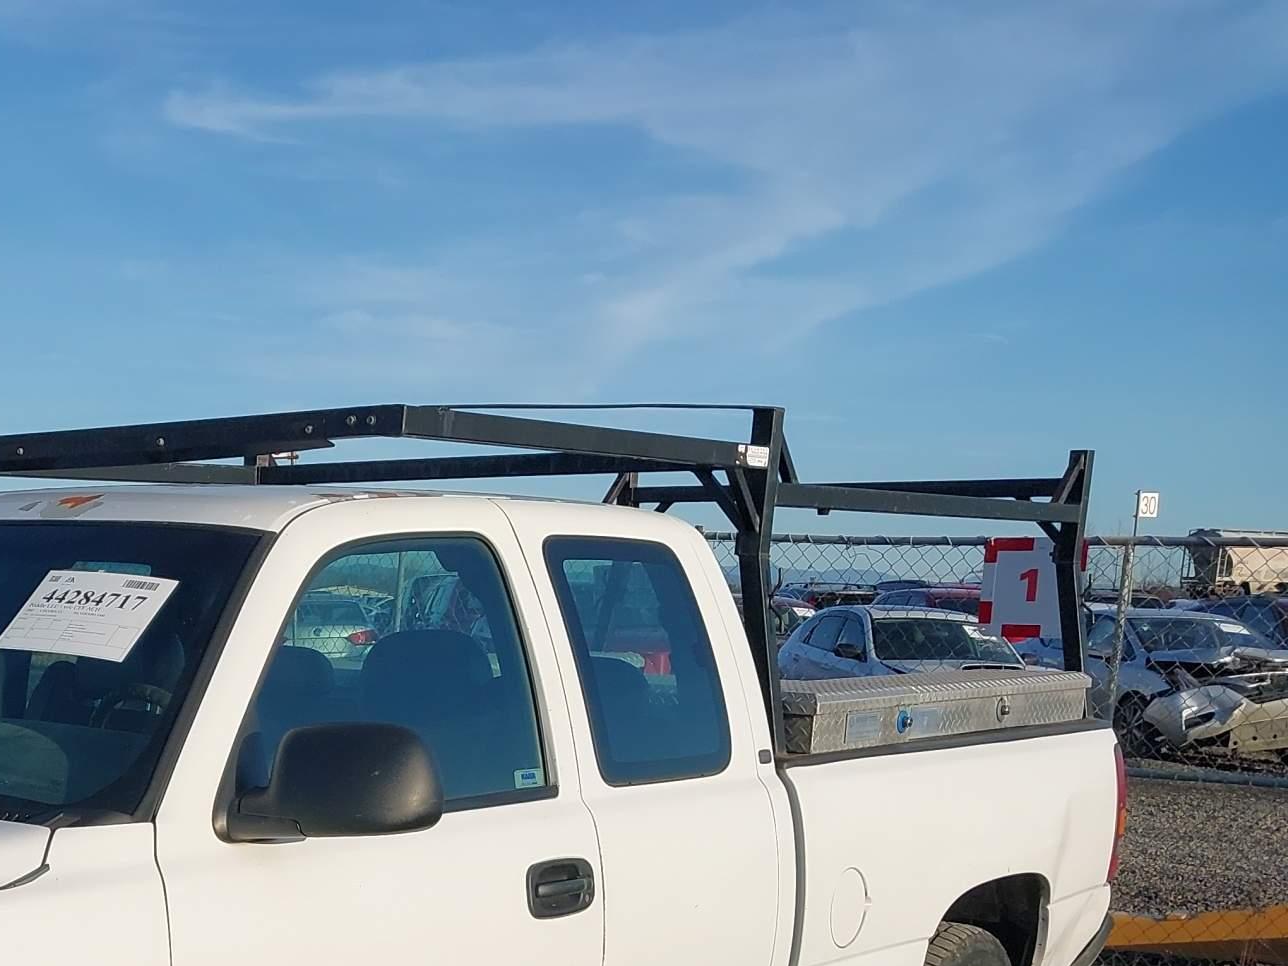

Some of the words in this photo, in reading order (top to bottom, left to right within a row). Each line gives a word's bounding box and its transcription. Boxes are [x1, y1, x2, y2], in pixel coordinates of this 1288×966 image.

[1140, 495, 1157, 516] 30
[1019, 568, 1039, 602] 1
[42, 588, 148, 611] 44284717
